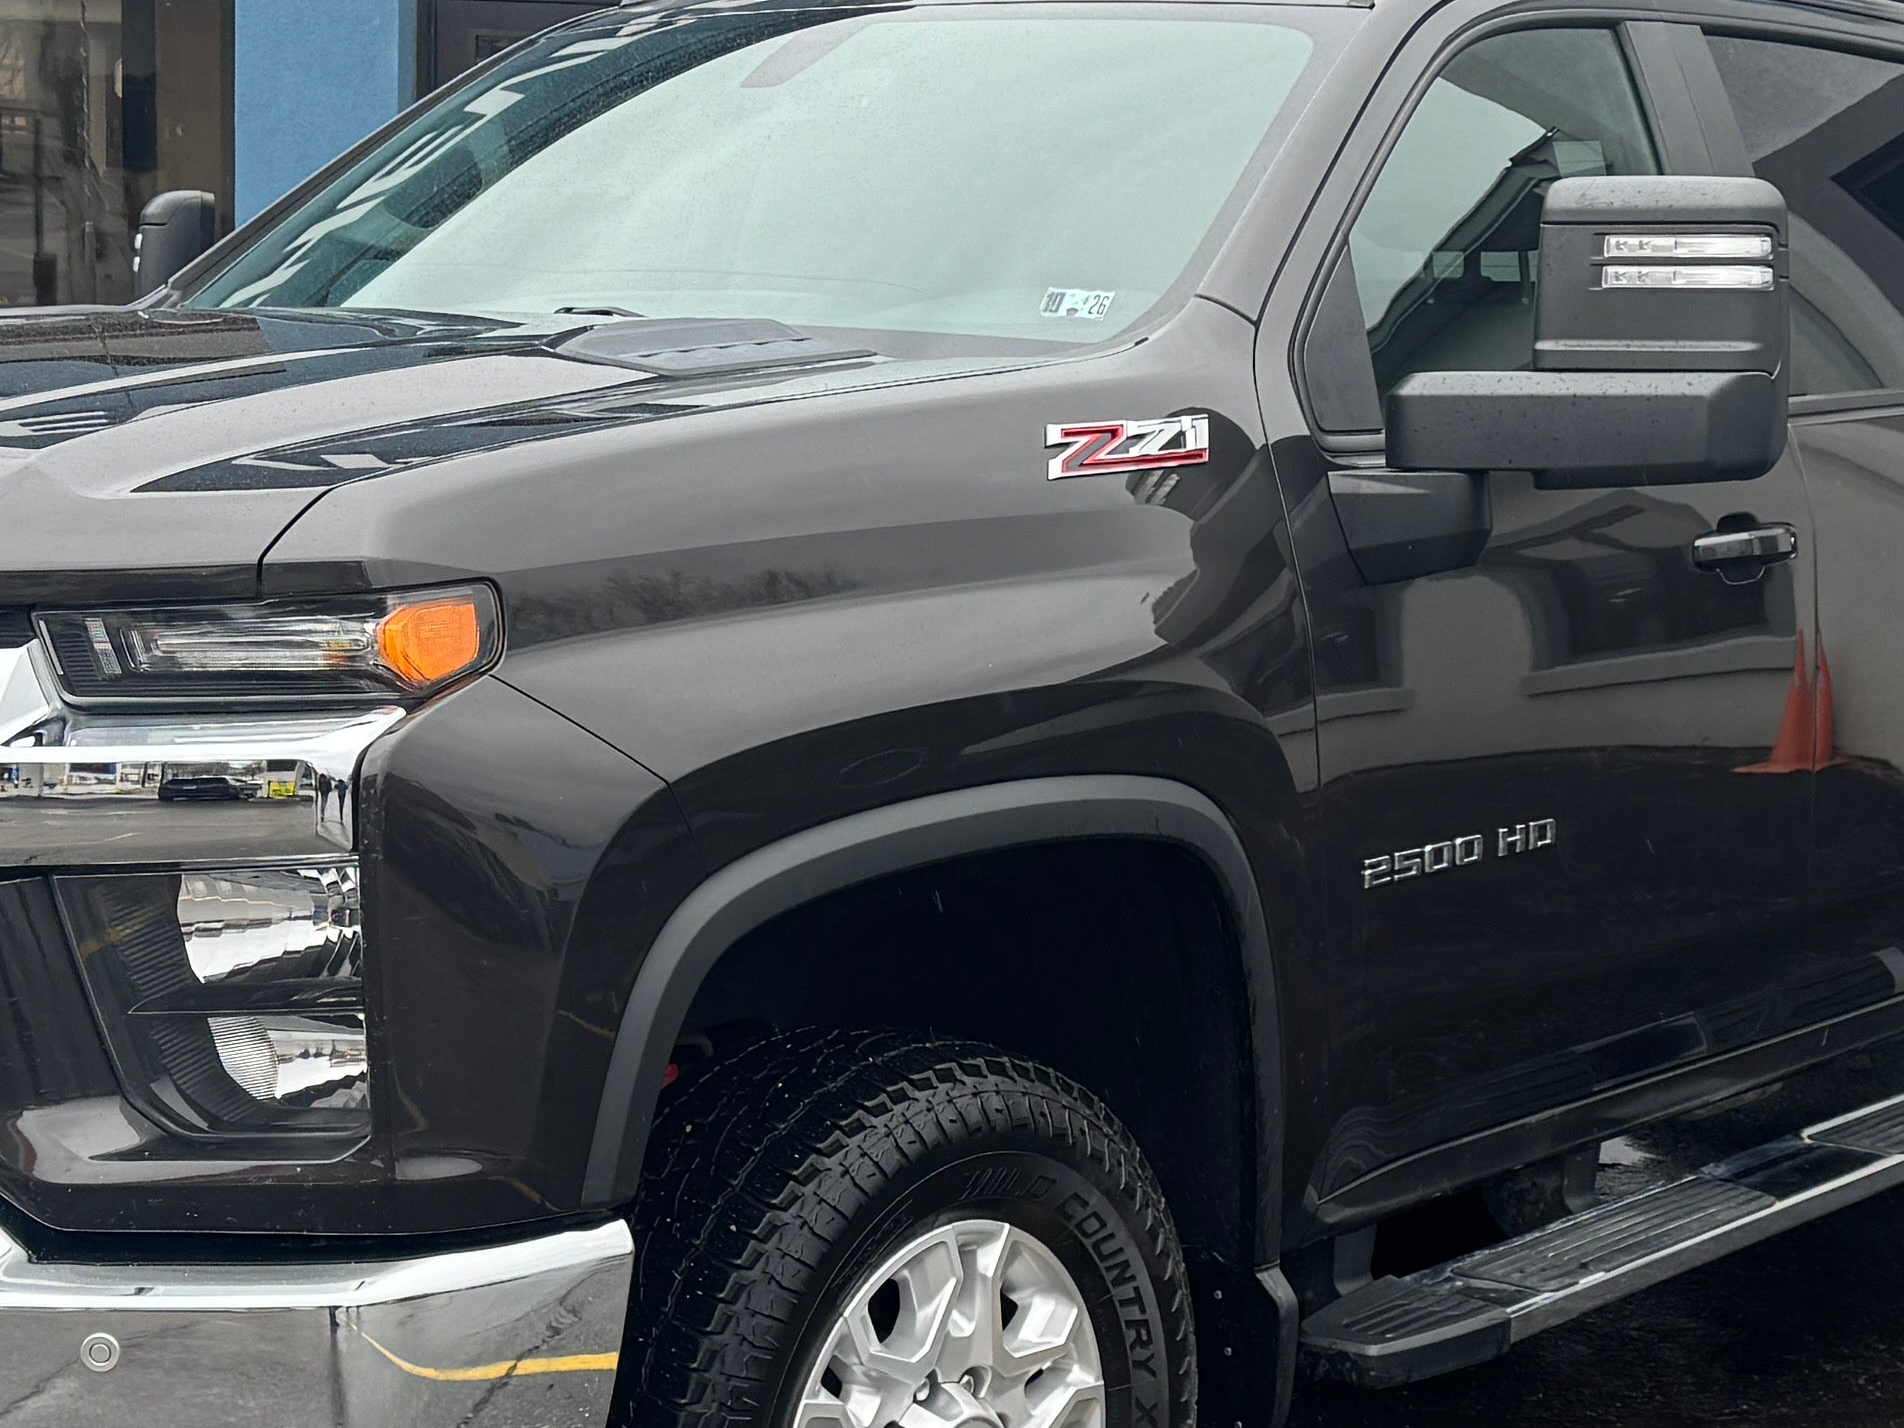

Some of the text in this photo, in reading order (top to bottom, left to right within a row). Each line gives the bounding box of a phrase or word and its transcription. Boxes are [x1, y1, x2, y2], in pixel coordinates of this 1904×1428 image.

[1088, 294, 1109, 315] 26
[1045, 414, 1209, 480] Z71
[1361, 818, 1557, 889] 2500 HD
[1055, 1191, 1158, 1379] COUNTRY
